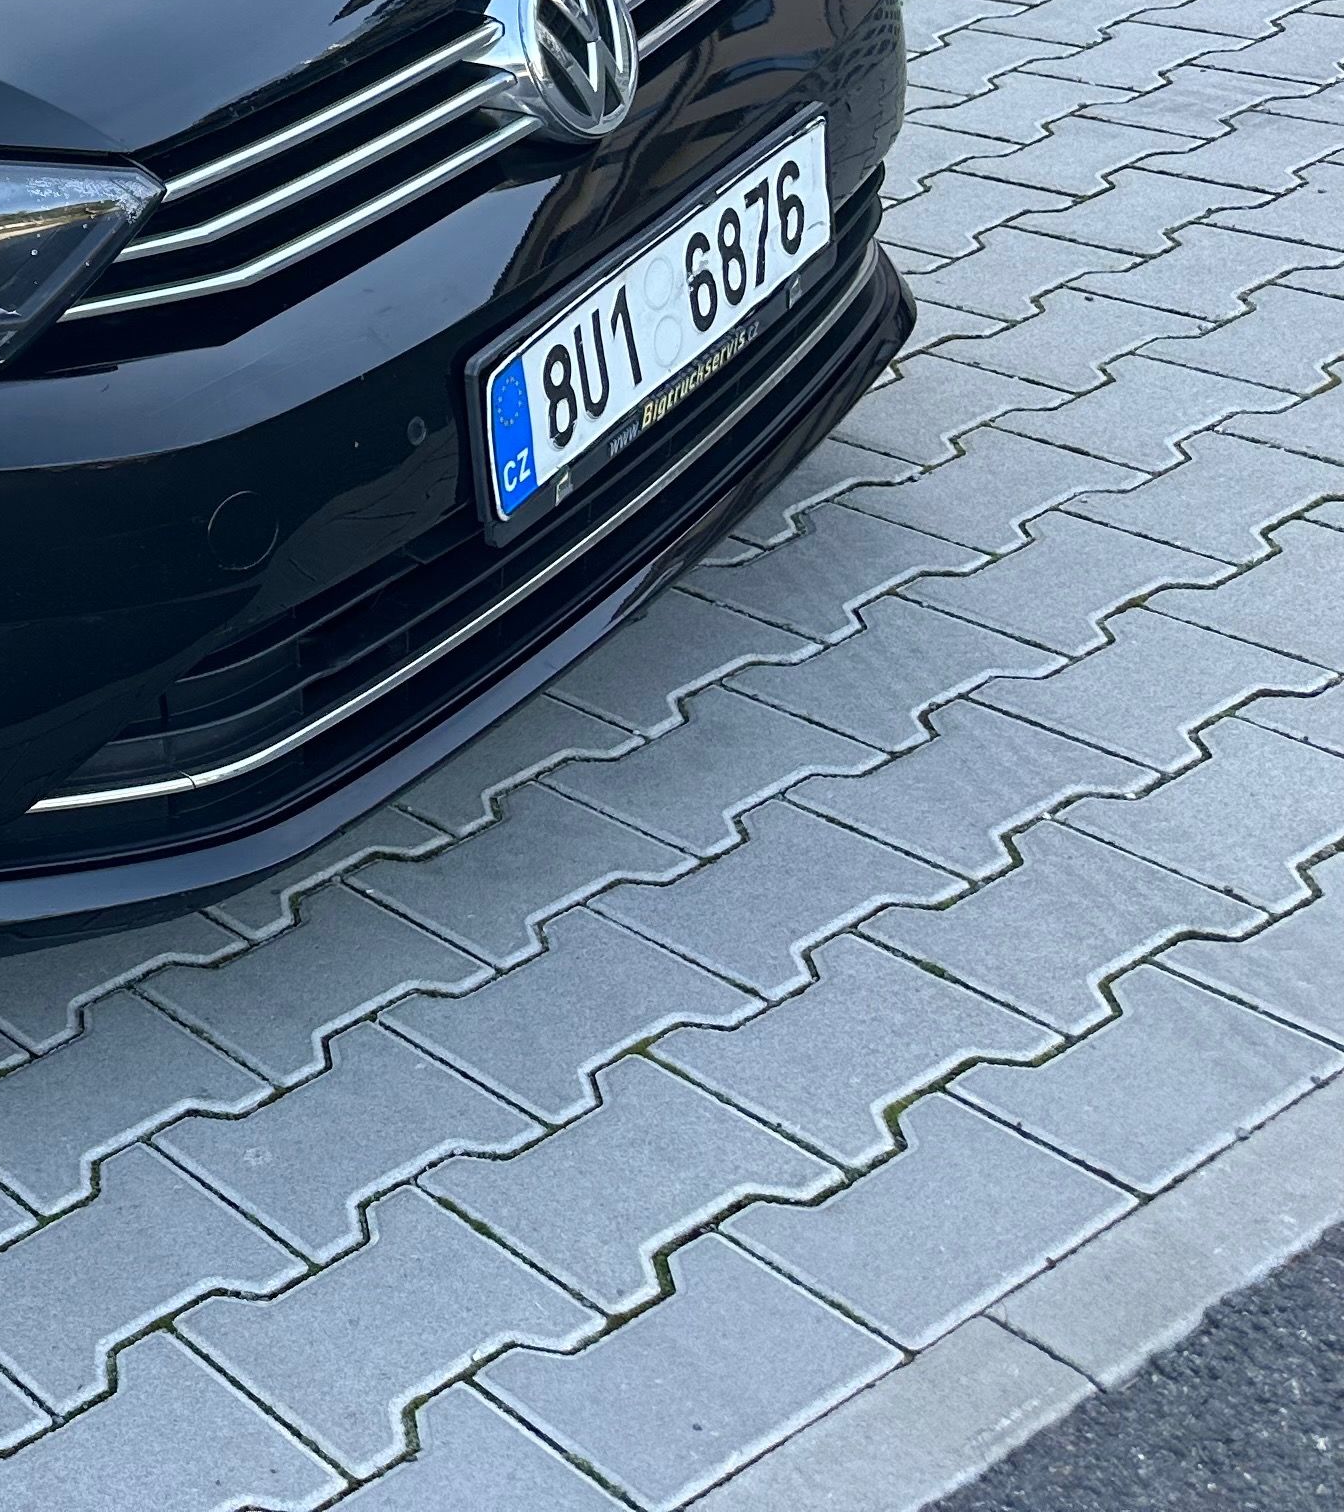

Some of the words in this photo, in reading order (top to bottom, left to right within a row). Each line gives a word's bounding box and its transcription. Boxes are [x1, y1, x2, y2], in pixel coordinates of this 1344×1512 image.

[543, 285, 643, 449] 8U1
[685, 160, 805, 332] 6876
[503, 447, 532, 493] CZ
